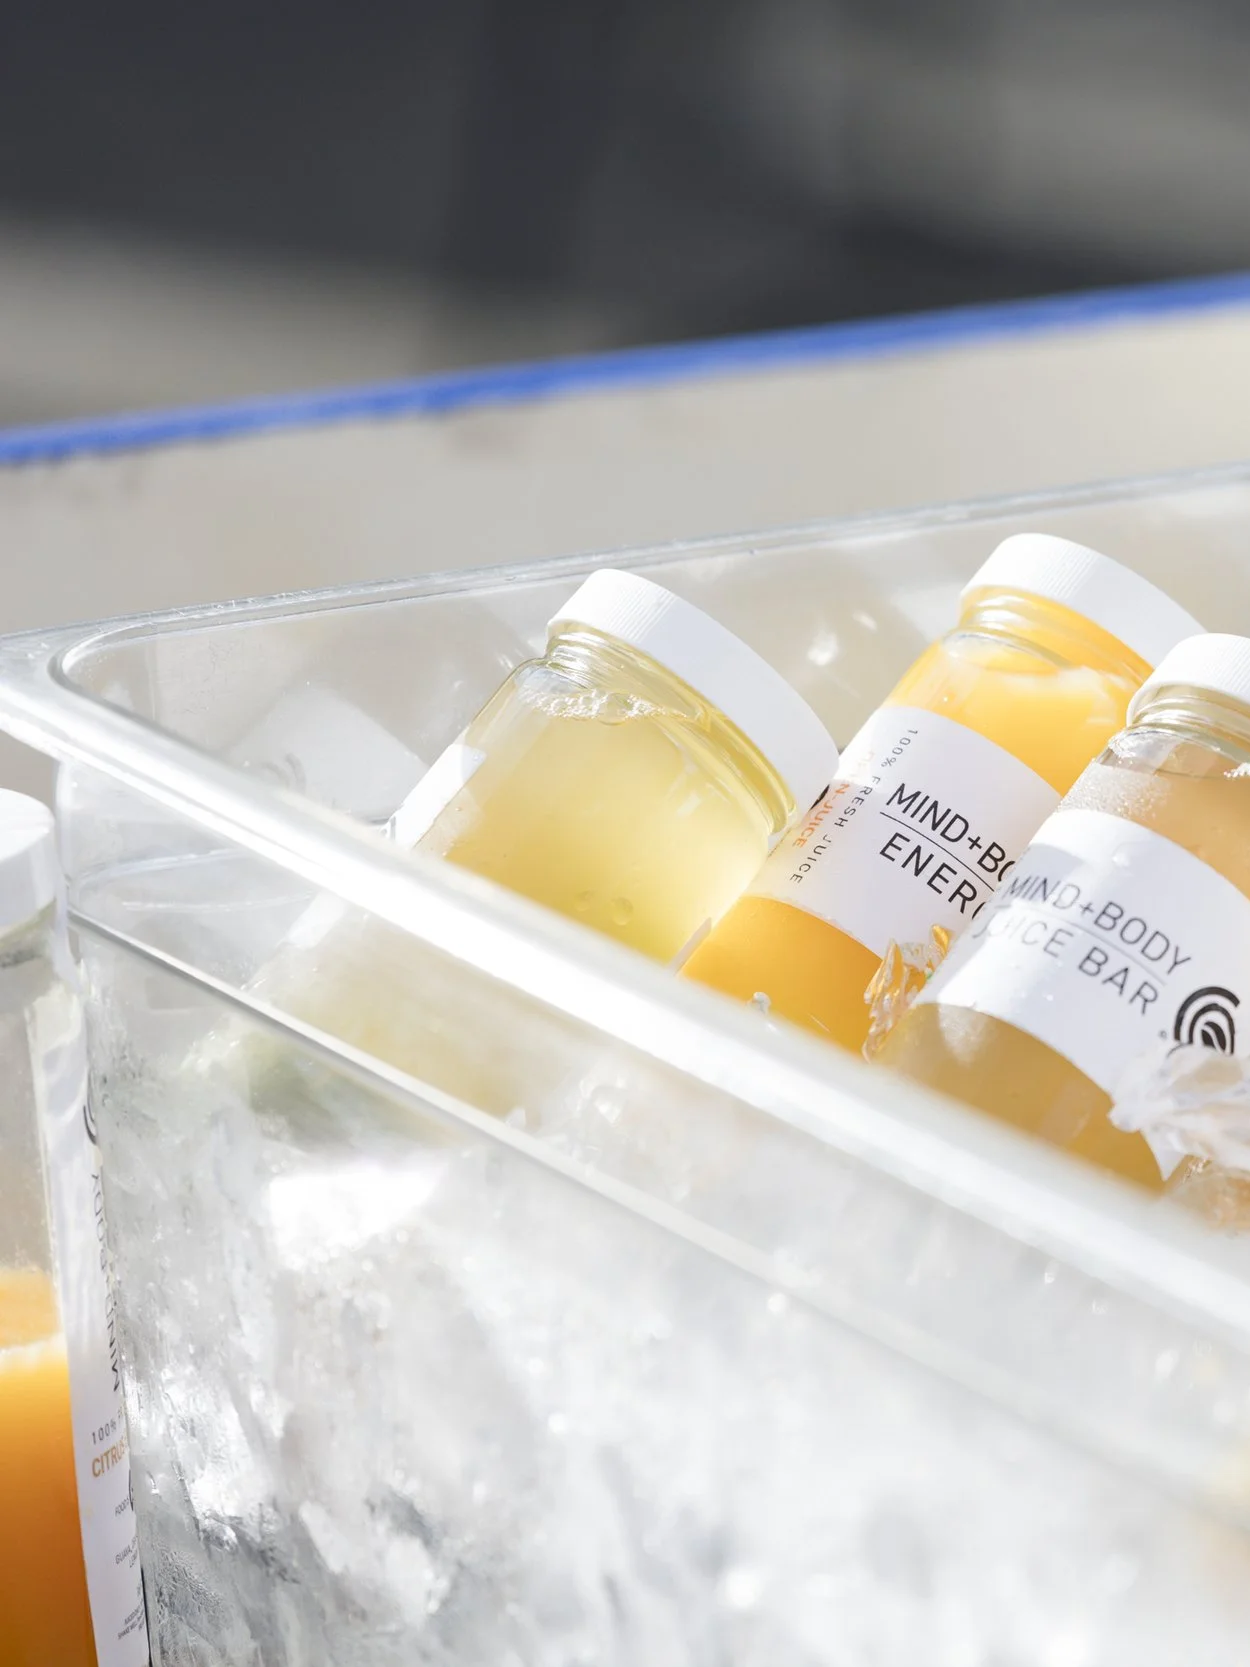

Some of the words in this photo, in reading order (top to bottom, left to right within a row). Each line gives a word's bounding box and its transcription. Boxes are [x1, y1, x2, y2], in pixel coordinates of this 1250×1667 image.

[880, 729, 919, 768] 100%
[834, 775, 881, 828] FRESH
[790, 834, 832, 884] JUICE
[1002, 876, 1192, 976] MIND+BODY
[1078, 946, 1159, 1016] BAR
